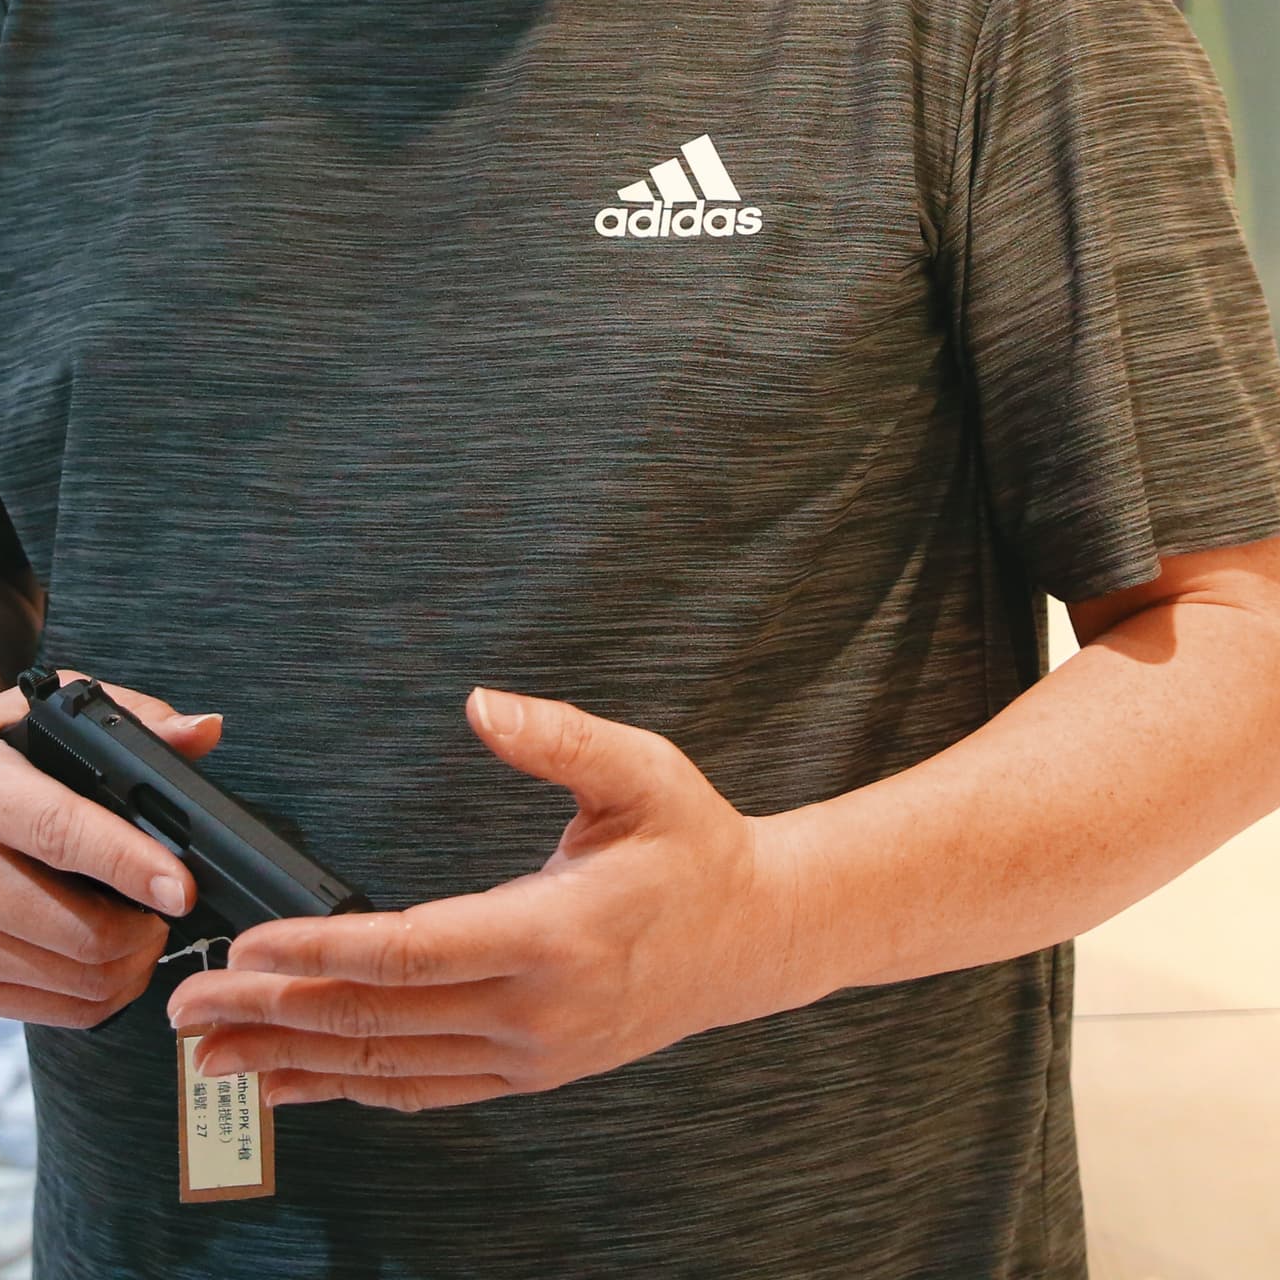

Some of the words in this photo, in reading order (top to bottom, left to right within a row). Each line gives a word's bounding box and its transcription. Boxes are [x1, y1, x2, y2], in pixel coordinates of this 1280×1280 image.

[594, 199, 763, 238] adidas
[236, 1072, 249, 1105] alther
[237, 1108, 250, 1130] PPK
